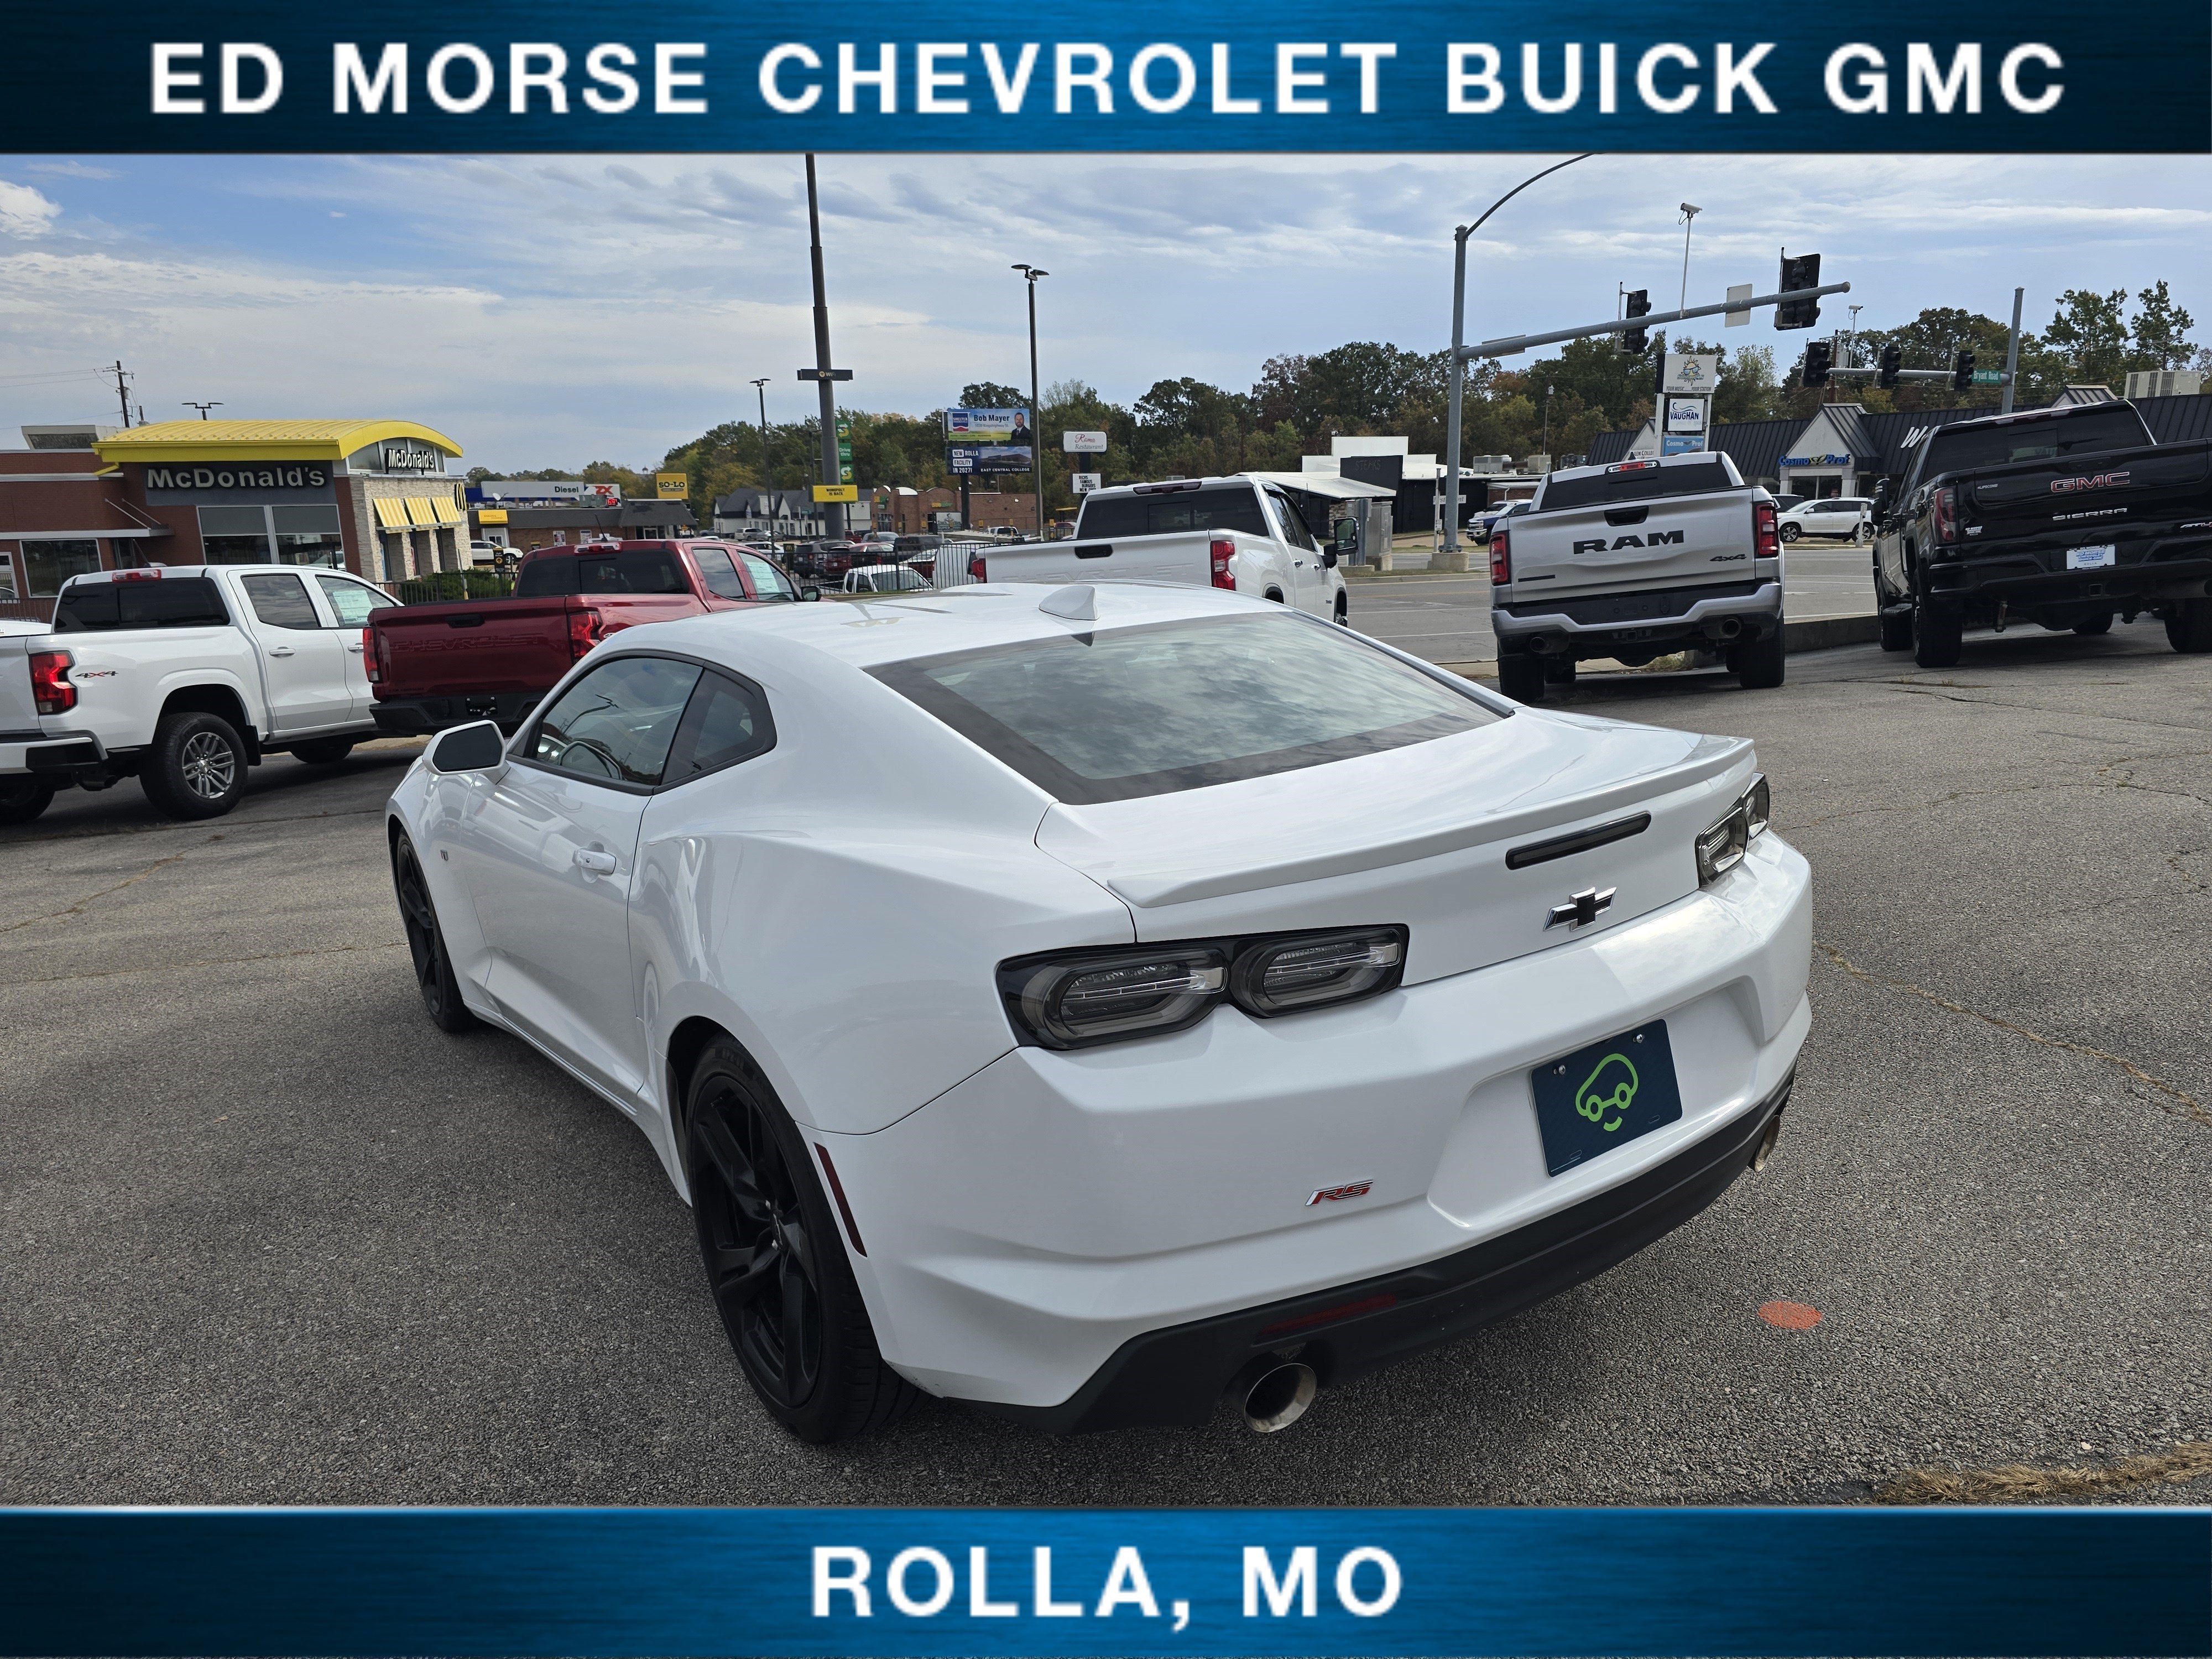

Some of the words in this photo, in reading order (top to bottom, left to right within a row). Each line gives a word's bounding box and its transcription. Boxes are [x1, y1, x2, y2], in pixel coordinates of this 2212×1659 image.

[1670, 411, 1699, 420] VAUGHAN
[388, 449, 434, 469] McDonald's
[1778, 455, 1810, 466] Cosmo
[1826, 453, 1850, 465] Prof
[147, 467, 325, 489] McDonald's
[2051, 472, 2130, 493] GMC
[2052, 508, 2127, 520] SIERRA
[1573, 530, 1684, 555] RAM
[1305, 1179, 1374, 1206] RS
